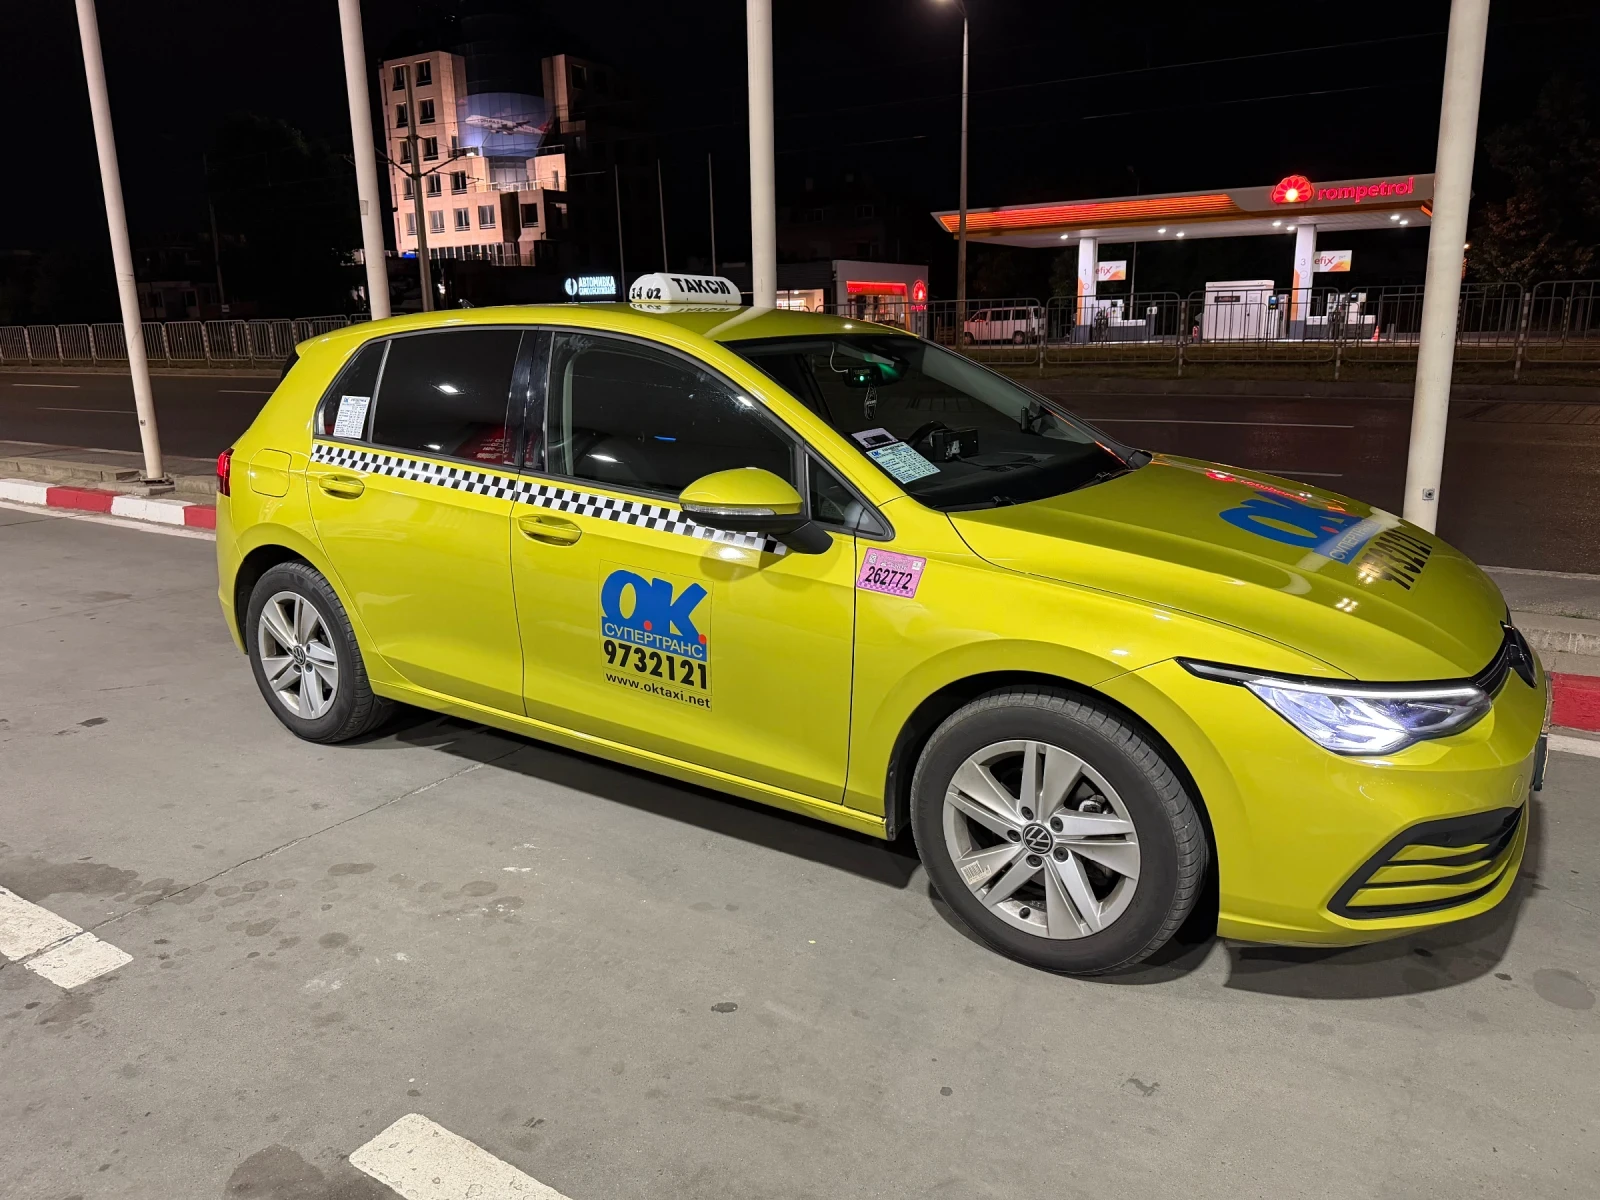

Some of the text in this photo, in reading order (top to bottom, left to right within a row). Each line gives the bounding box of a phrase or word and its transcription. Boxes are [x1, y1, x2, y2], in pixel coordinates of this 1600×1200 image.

[1318, 176, 1414, 203] rompetrol
[1314, 255, 1336, 266] efix
[579, 275, 616, 287] АВТОМИВКА
[671, 277, 732, 294] ТАКСИ
[864, 565, 913, 590] 262772
[604, 622, 703, 658] СУПЕРТРАНС
[603, 639, 707, 690] 9732121
[605, 672, 711, 709] www.oktaxi.net
